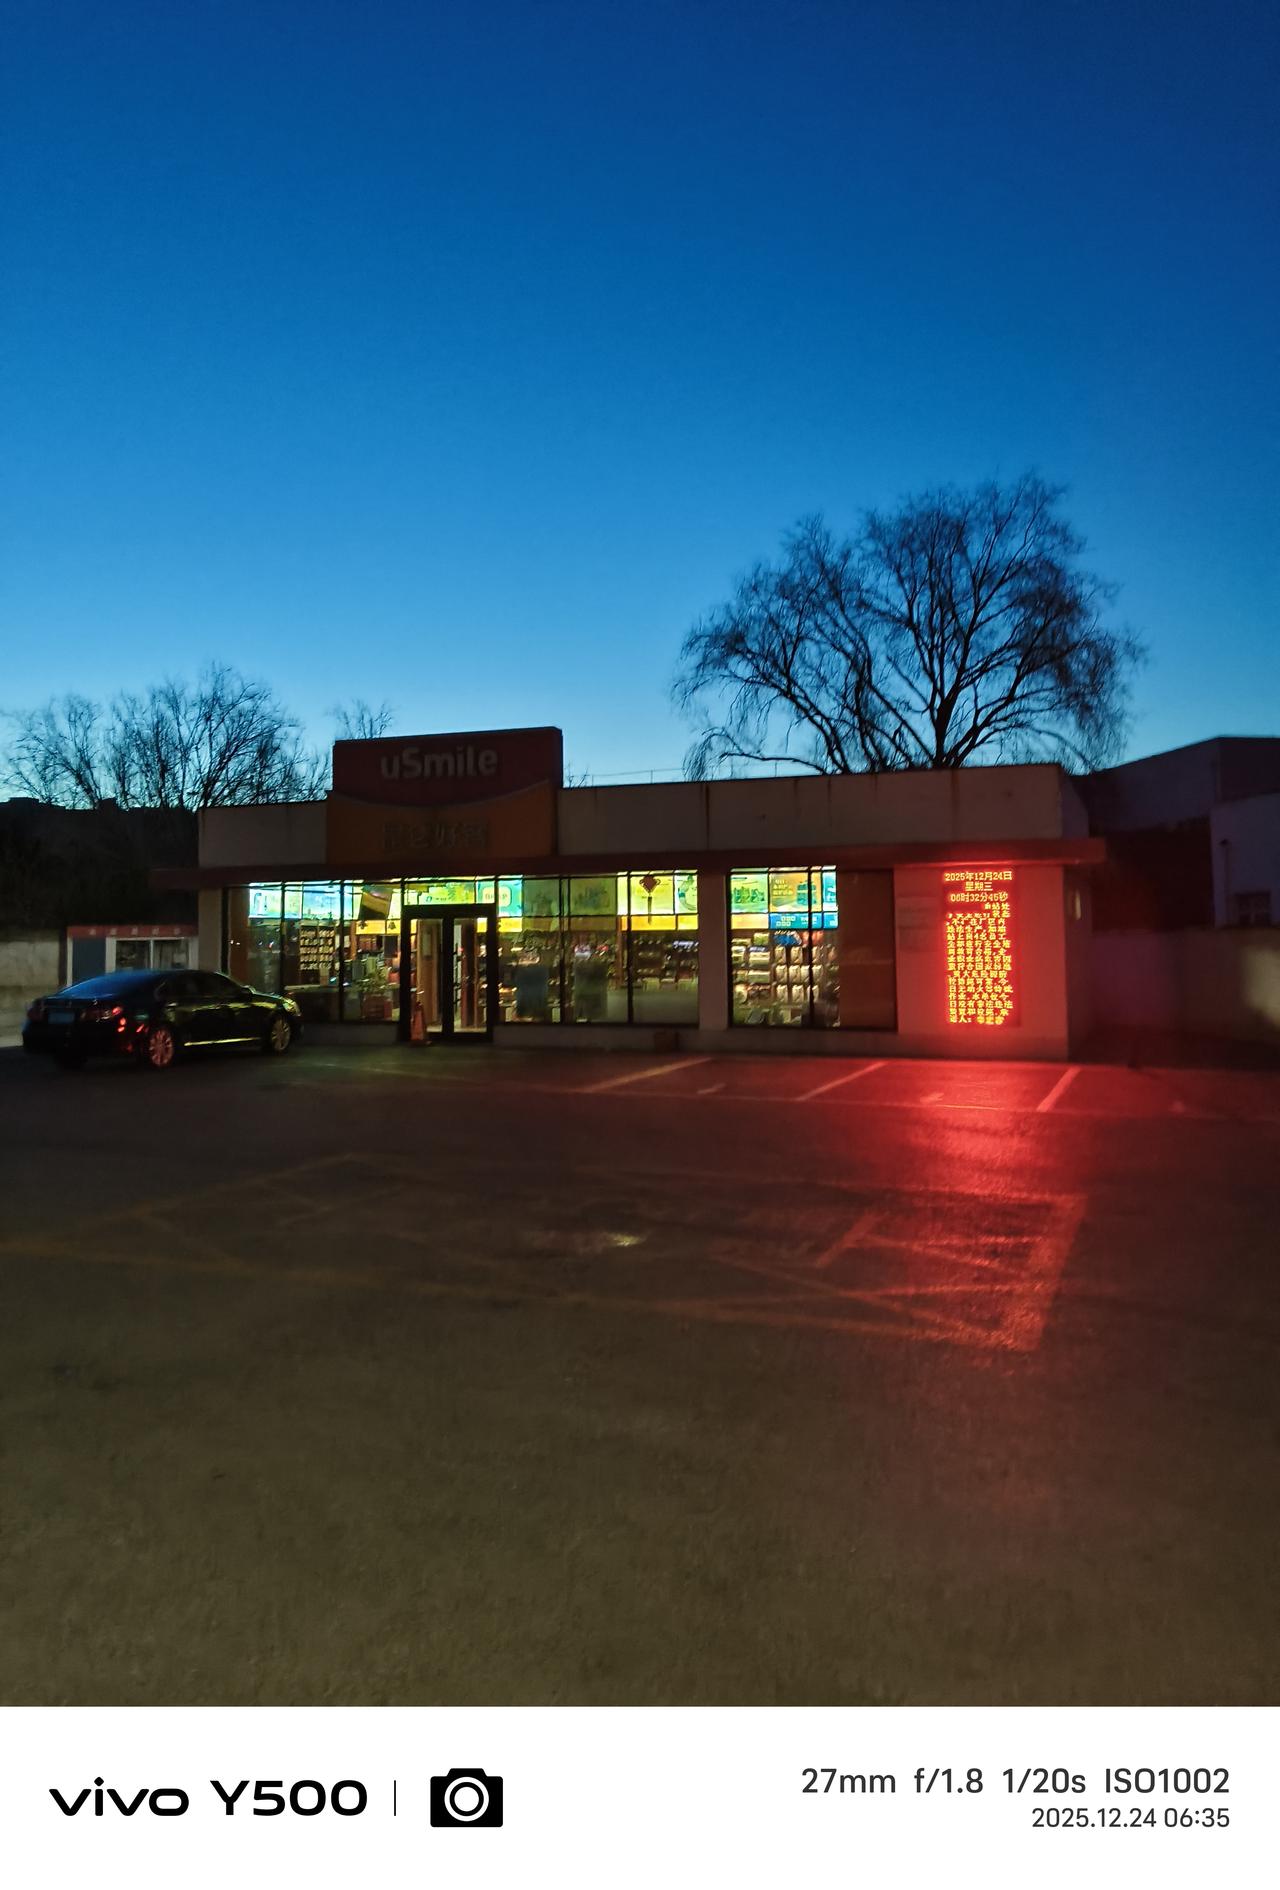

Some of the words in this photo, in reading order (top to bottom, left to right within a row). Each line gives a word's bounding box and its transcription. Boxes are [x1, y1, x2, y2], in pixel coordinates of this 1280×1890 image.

[380, 745, 498, 779] uSmile
[944, 871, 1012, 881] 2025年12月24日
[965, 881, 993, 891] 星期三
